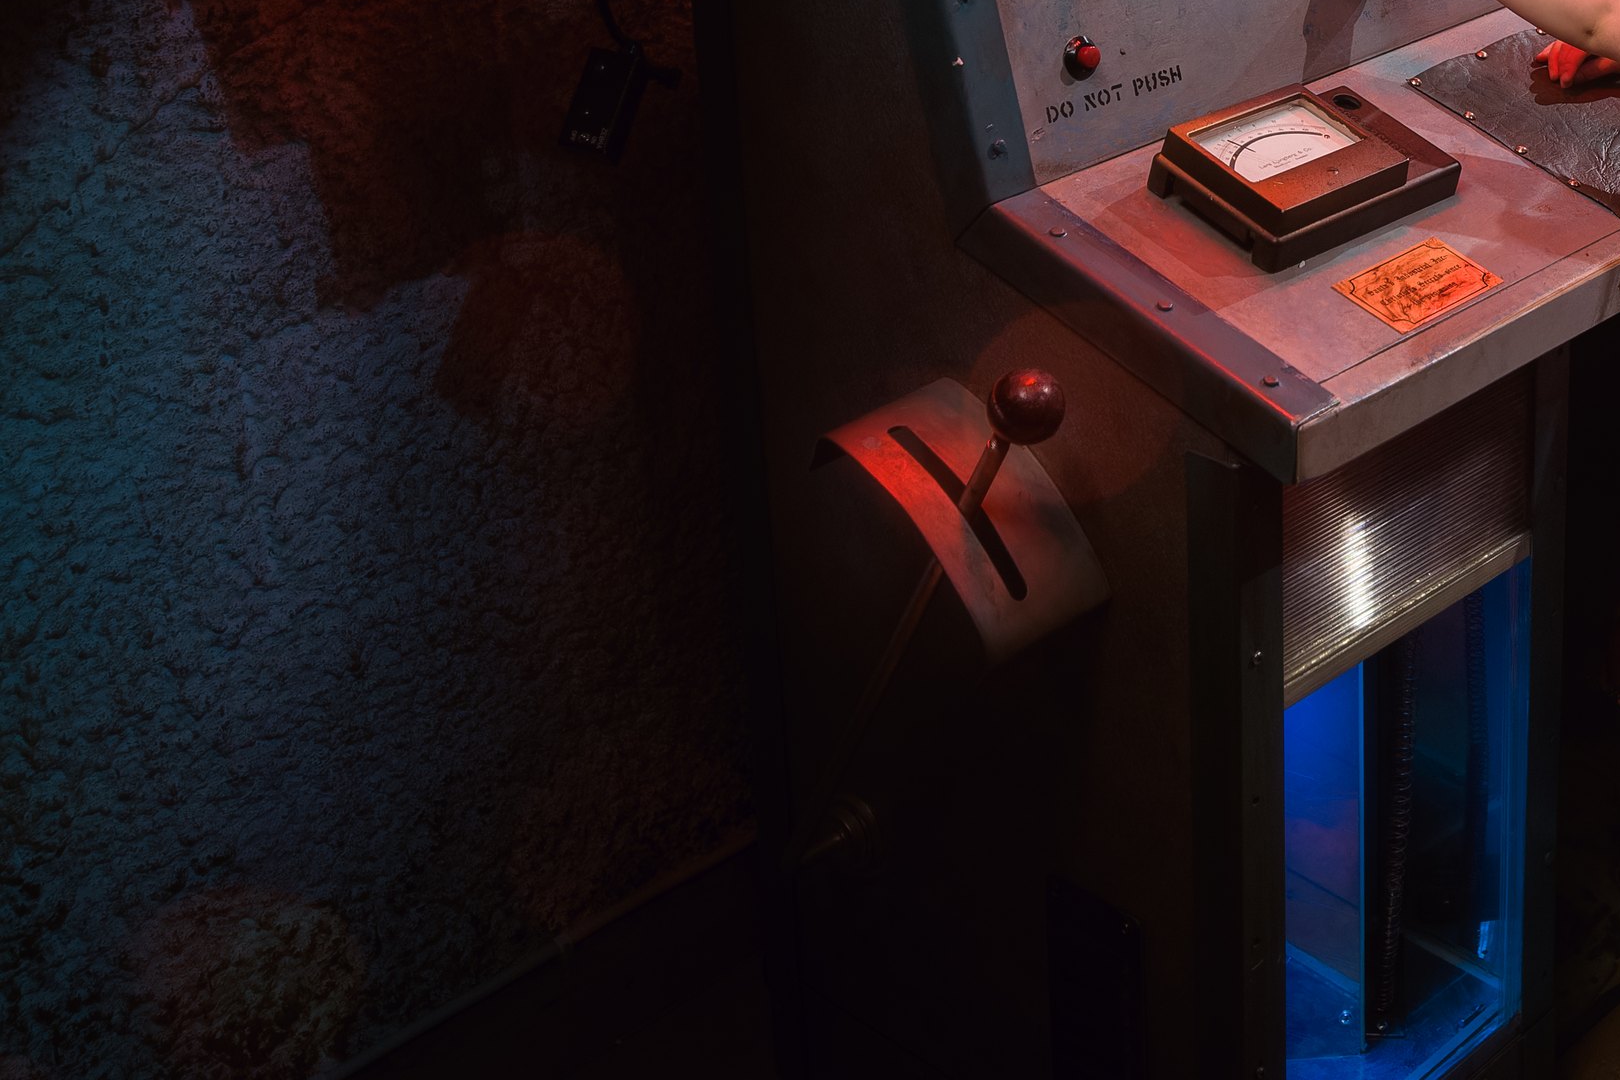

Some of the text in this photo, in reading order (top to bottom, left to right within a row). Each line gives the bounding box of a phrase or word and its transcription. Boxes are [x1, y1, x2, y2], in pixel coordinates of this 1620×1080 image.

[1045, 64, 1183, 124] DO NOT PUSH
